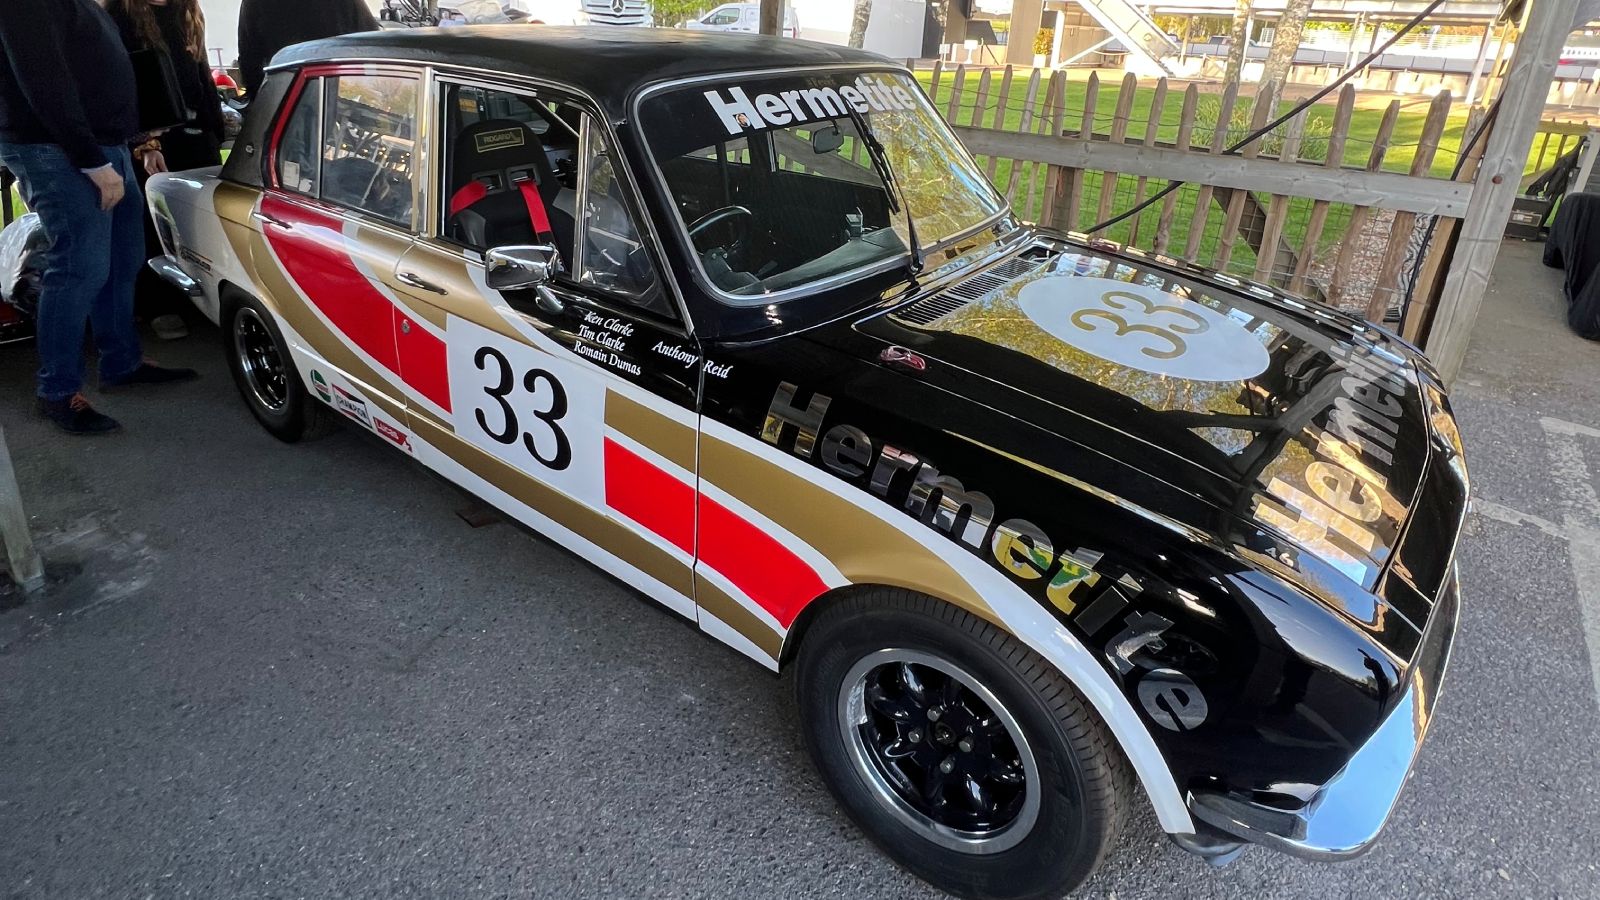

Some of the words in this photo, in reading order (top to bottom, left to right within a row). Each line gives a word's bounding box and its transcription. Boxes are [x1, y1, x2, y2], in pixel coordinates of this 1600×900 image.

[704, 76, 916, 135] Hermetite
[578, 324, 595, 341] Tim
[596, 331, 625, 352] Clarke
[584, 311, 602, 325] Ken
[603, 318, 634, 337] Clarke
[1071, 291, 1209, 359] 33
[574, 340, 608, 363] Romain
[609, 353, 642, 376] Dumas
[651, 341, 699, 369] Anthony
[703, 360, 733, 379] Reid
[474, 346, 572, 471] 33
[760, 381, 1208, 732] Hermetite
